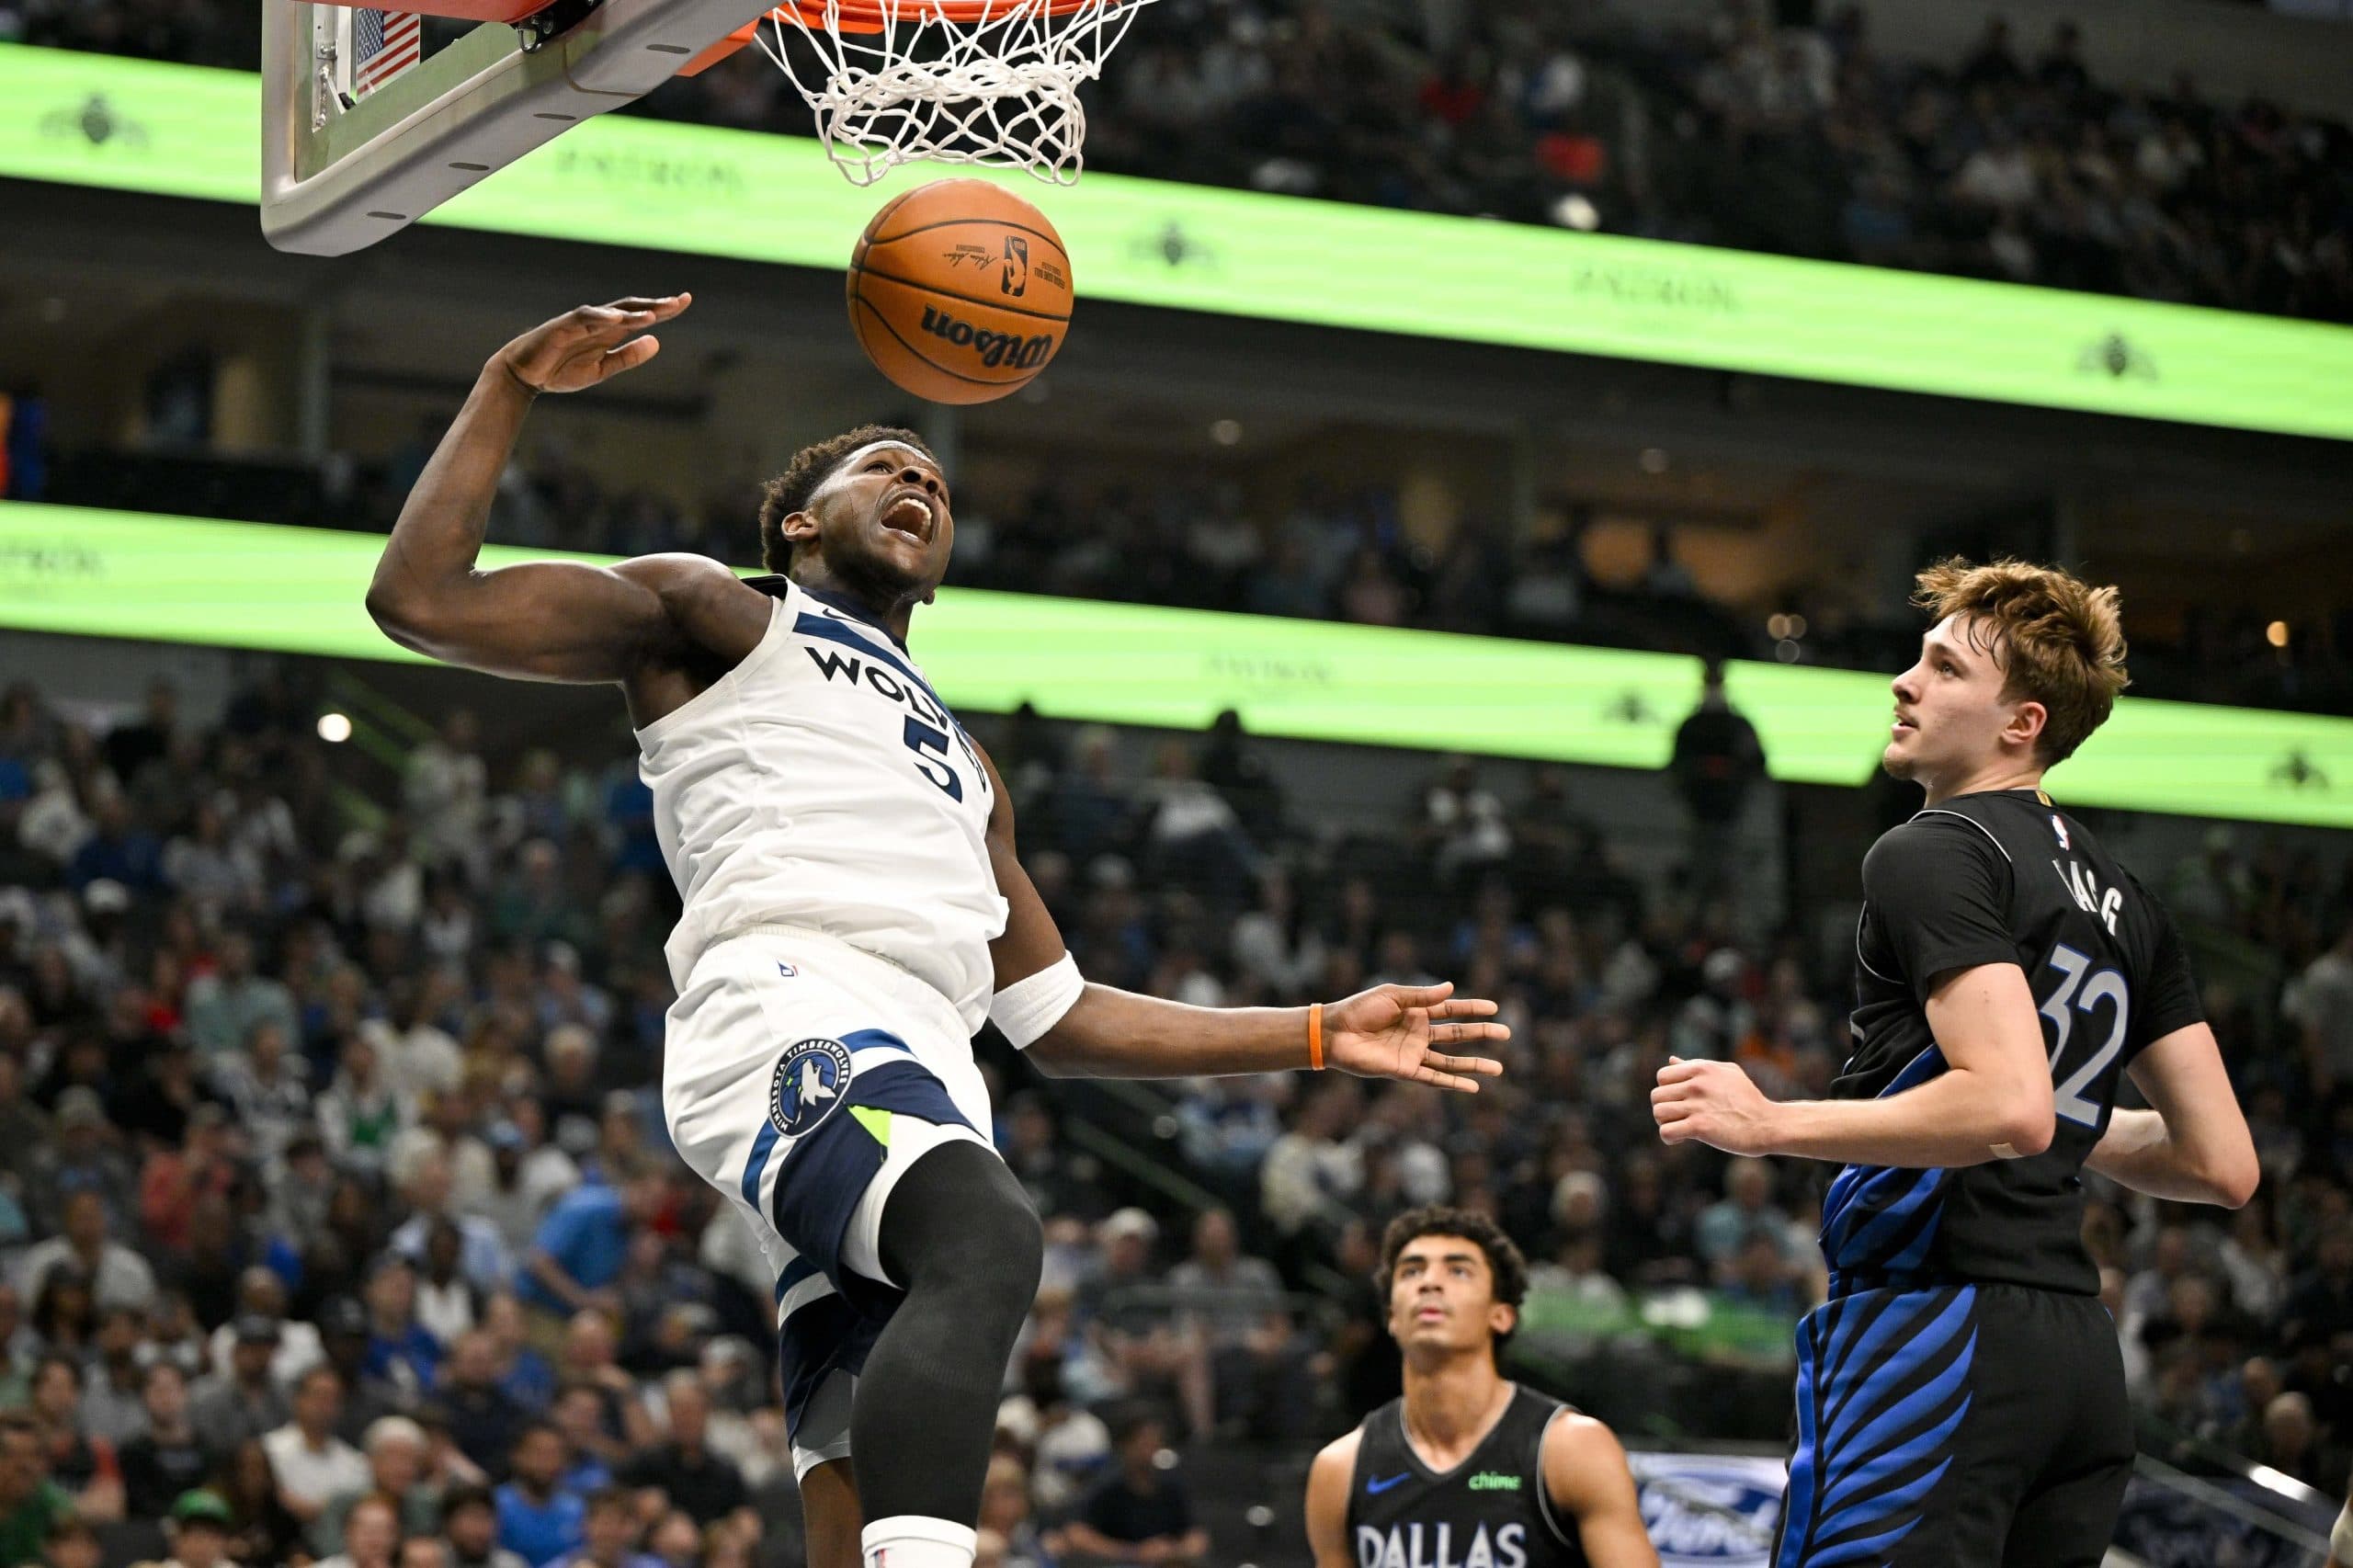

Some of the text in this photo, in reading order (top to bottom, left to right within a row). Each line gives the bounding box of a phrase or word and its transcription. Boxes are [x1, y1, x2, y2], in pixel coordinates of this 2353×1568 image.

[921, 302, 1053, 369] Wilson
[904, 714, 963, 803] 5
[787, 1040, 848, 1084] TIMBERWOLVES
[2040, 942, 2130, 1128] 32
[1469, 1471, 1522, 1491] chime
[1357, 1520, 1528, 1568] DALLAS
